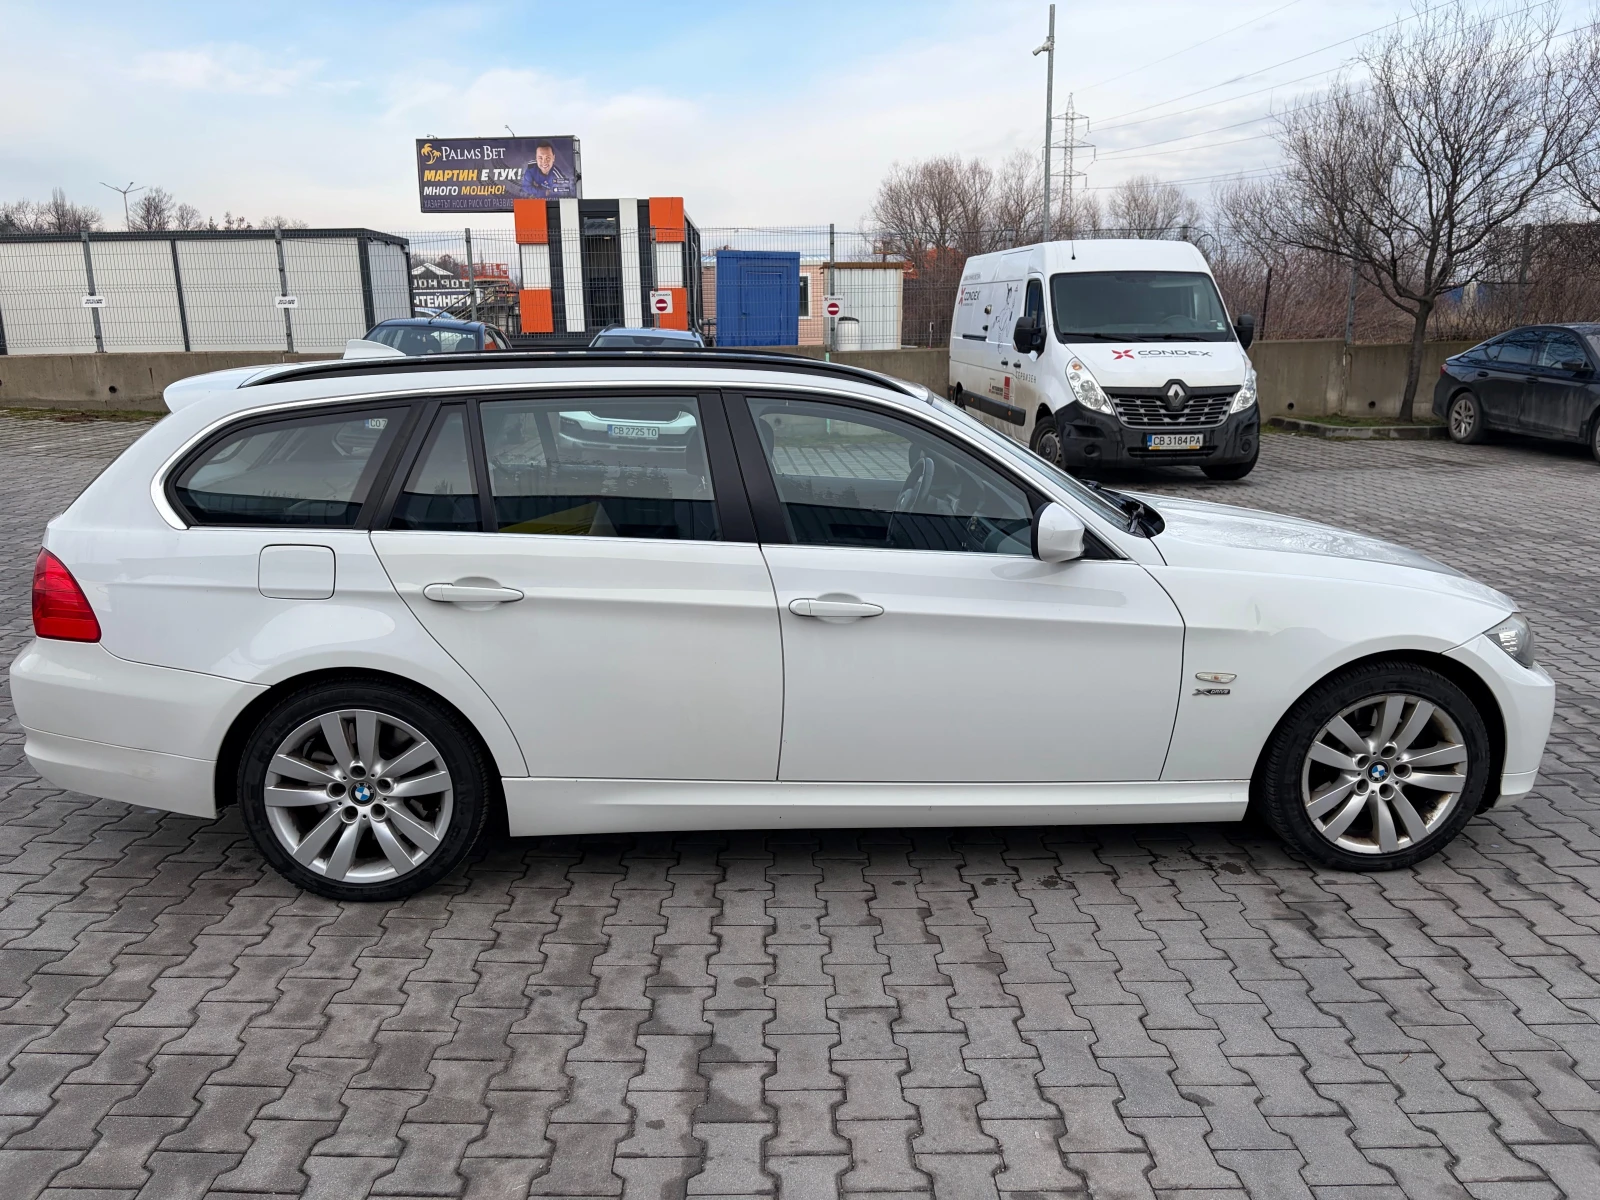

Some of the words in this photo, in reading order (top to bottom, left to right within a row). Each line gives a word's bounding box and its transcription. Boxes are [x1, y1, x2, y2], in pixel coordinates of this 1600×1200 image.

[441, 146, 481, 161] PALMS
[484, 145, 506, 160] BET
[423, 169, 478, 182] МАРТИН
[480, 169, 489, 181] Е
[493, 168, 522, 181] ТУК!
[423, 186, 458, 196] МНОГО
[461, 185, 505, 197] МОЩНО!
[452, 199, 467, 208] НОСИ
[468, 199, 482, 208] РИСК
[484, 199, 492, 207] ОТ
[613, 426, 624, 435] CB
[625, 427, 645, 436] 2725
[1153, 436, 1165, 446] CB
[1166, 436, 1188, 446] 3184
[1189, 436, 1201, 446] PA
